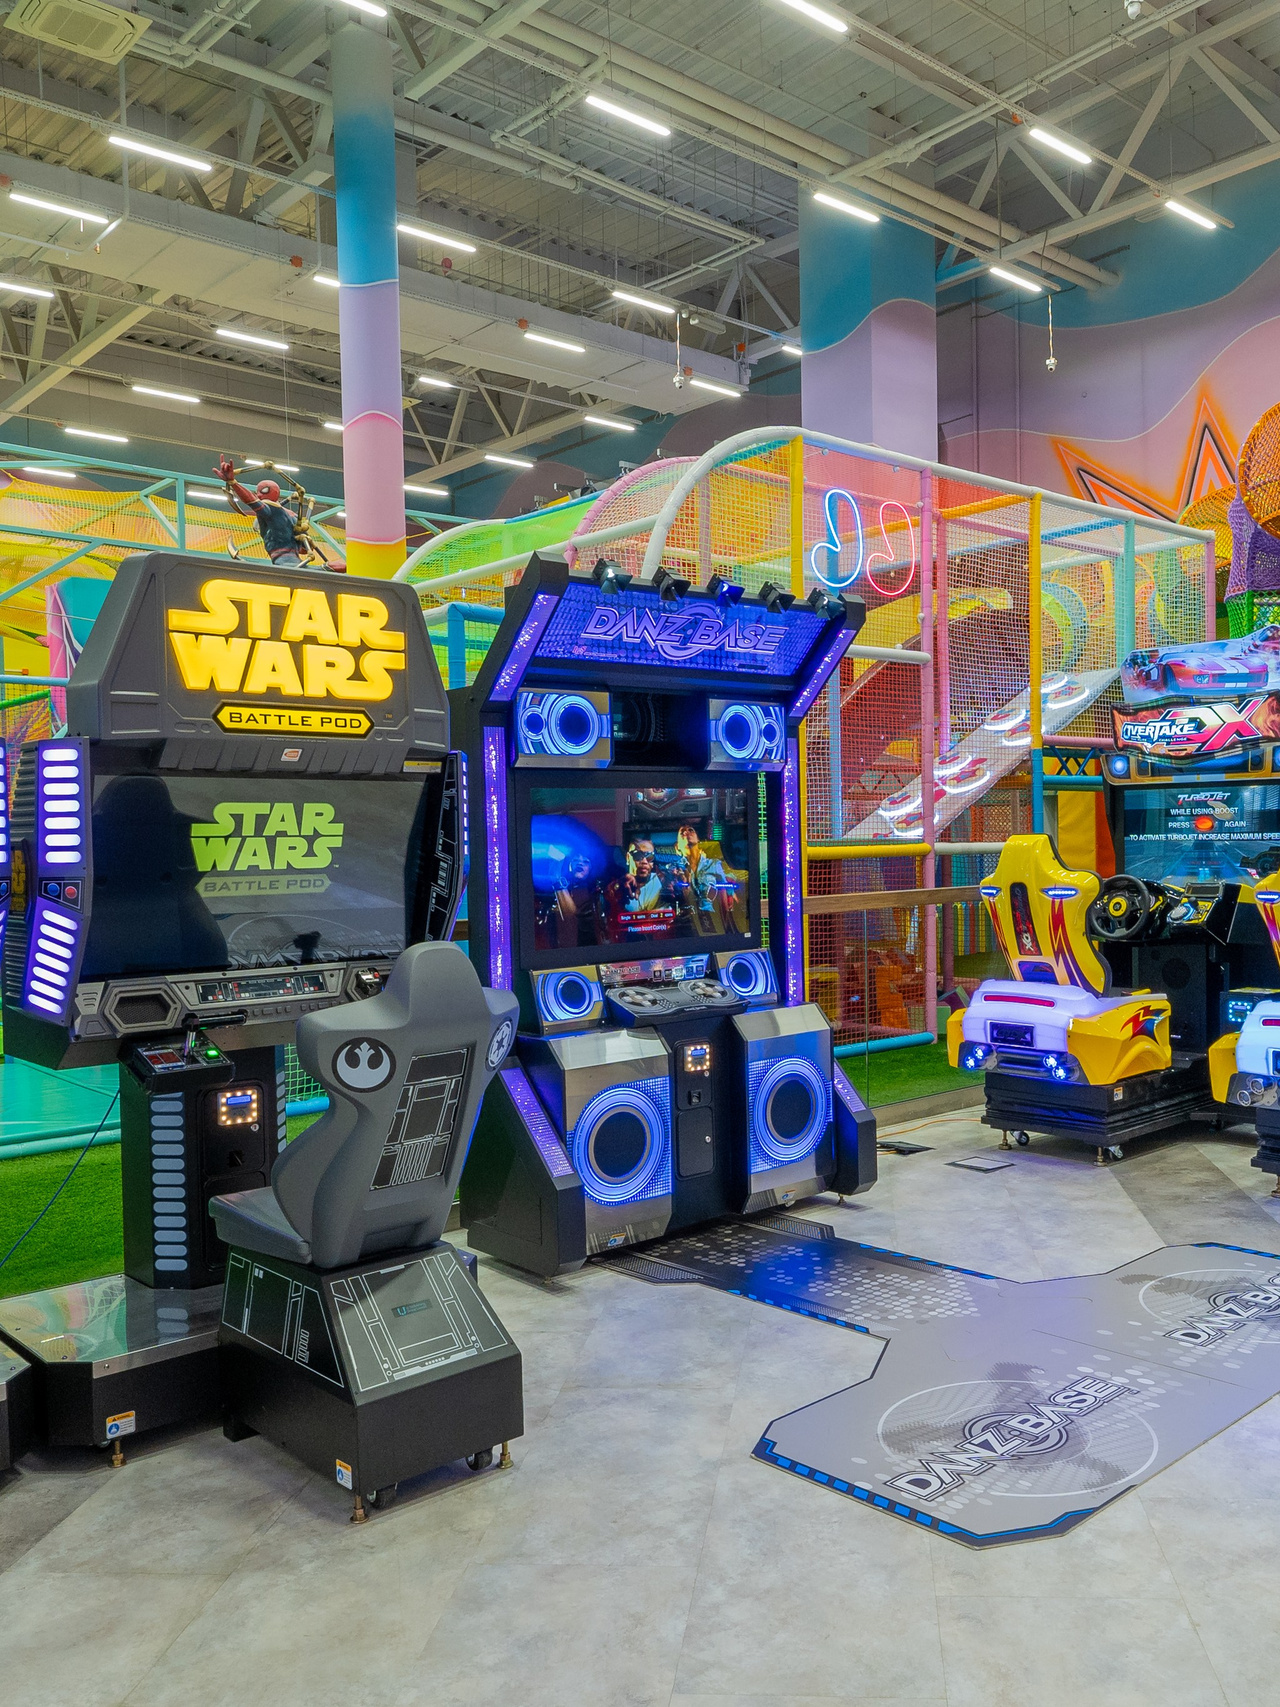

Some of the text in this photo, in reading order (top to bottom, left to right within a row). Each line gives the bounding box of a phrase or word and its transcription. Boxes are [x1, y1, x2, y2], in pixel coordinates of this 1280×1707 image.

[169, 579, 405, 650] STAR
[169, 632, 405, 701] WARS
[229, 711, 362, 729] BATTLE POD
[1166, 695, 1269, 752] DX
[190, 802, 344, 837] STAR
[1192, 807, 1213, 815] USING
[190, 836, 344, 872] WARS
[204, 876, 326, 892] BATTLE POD
